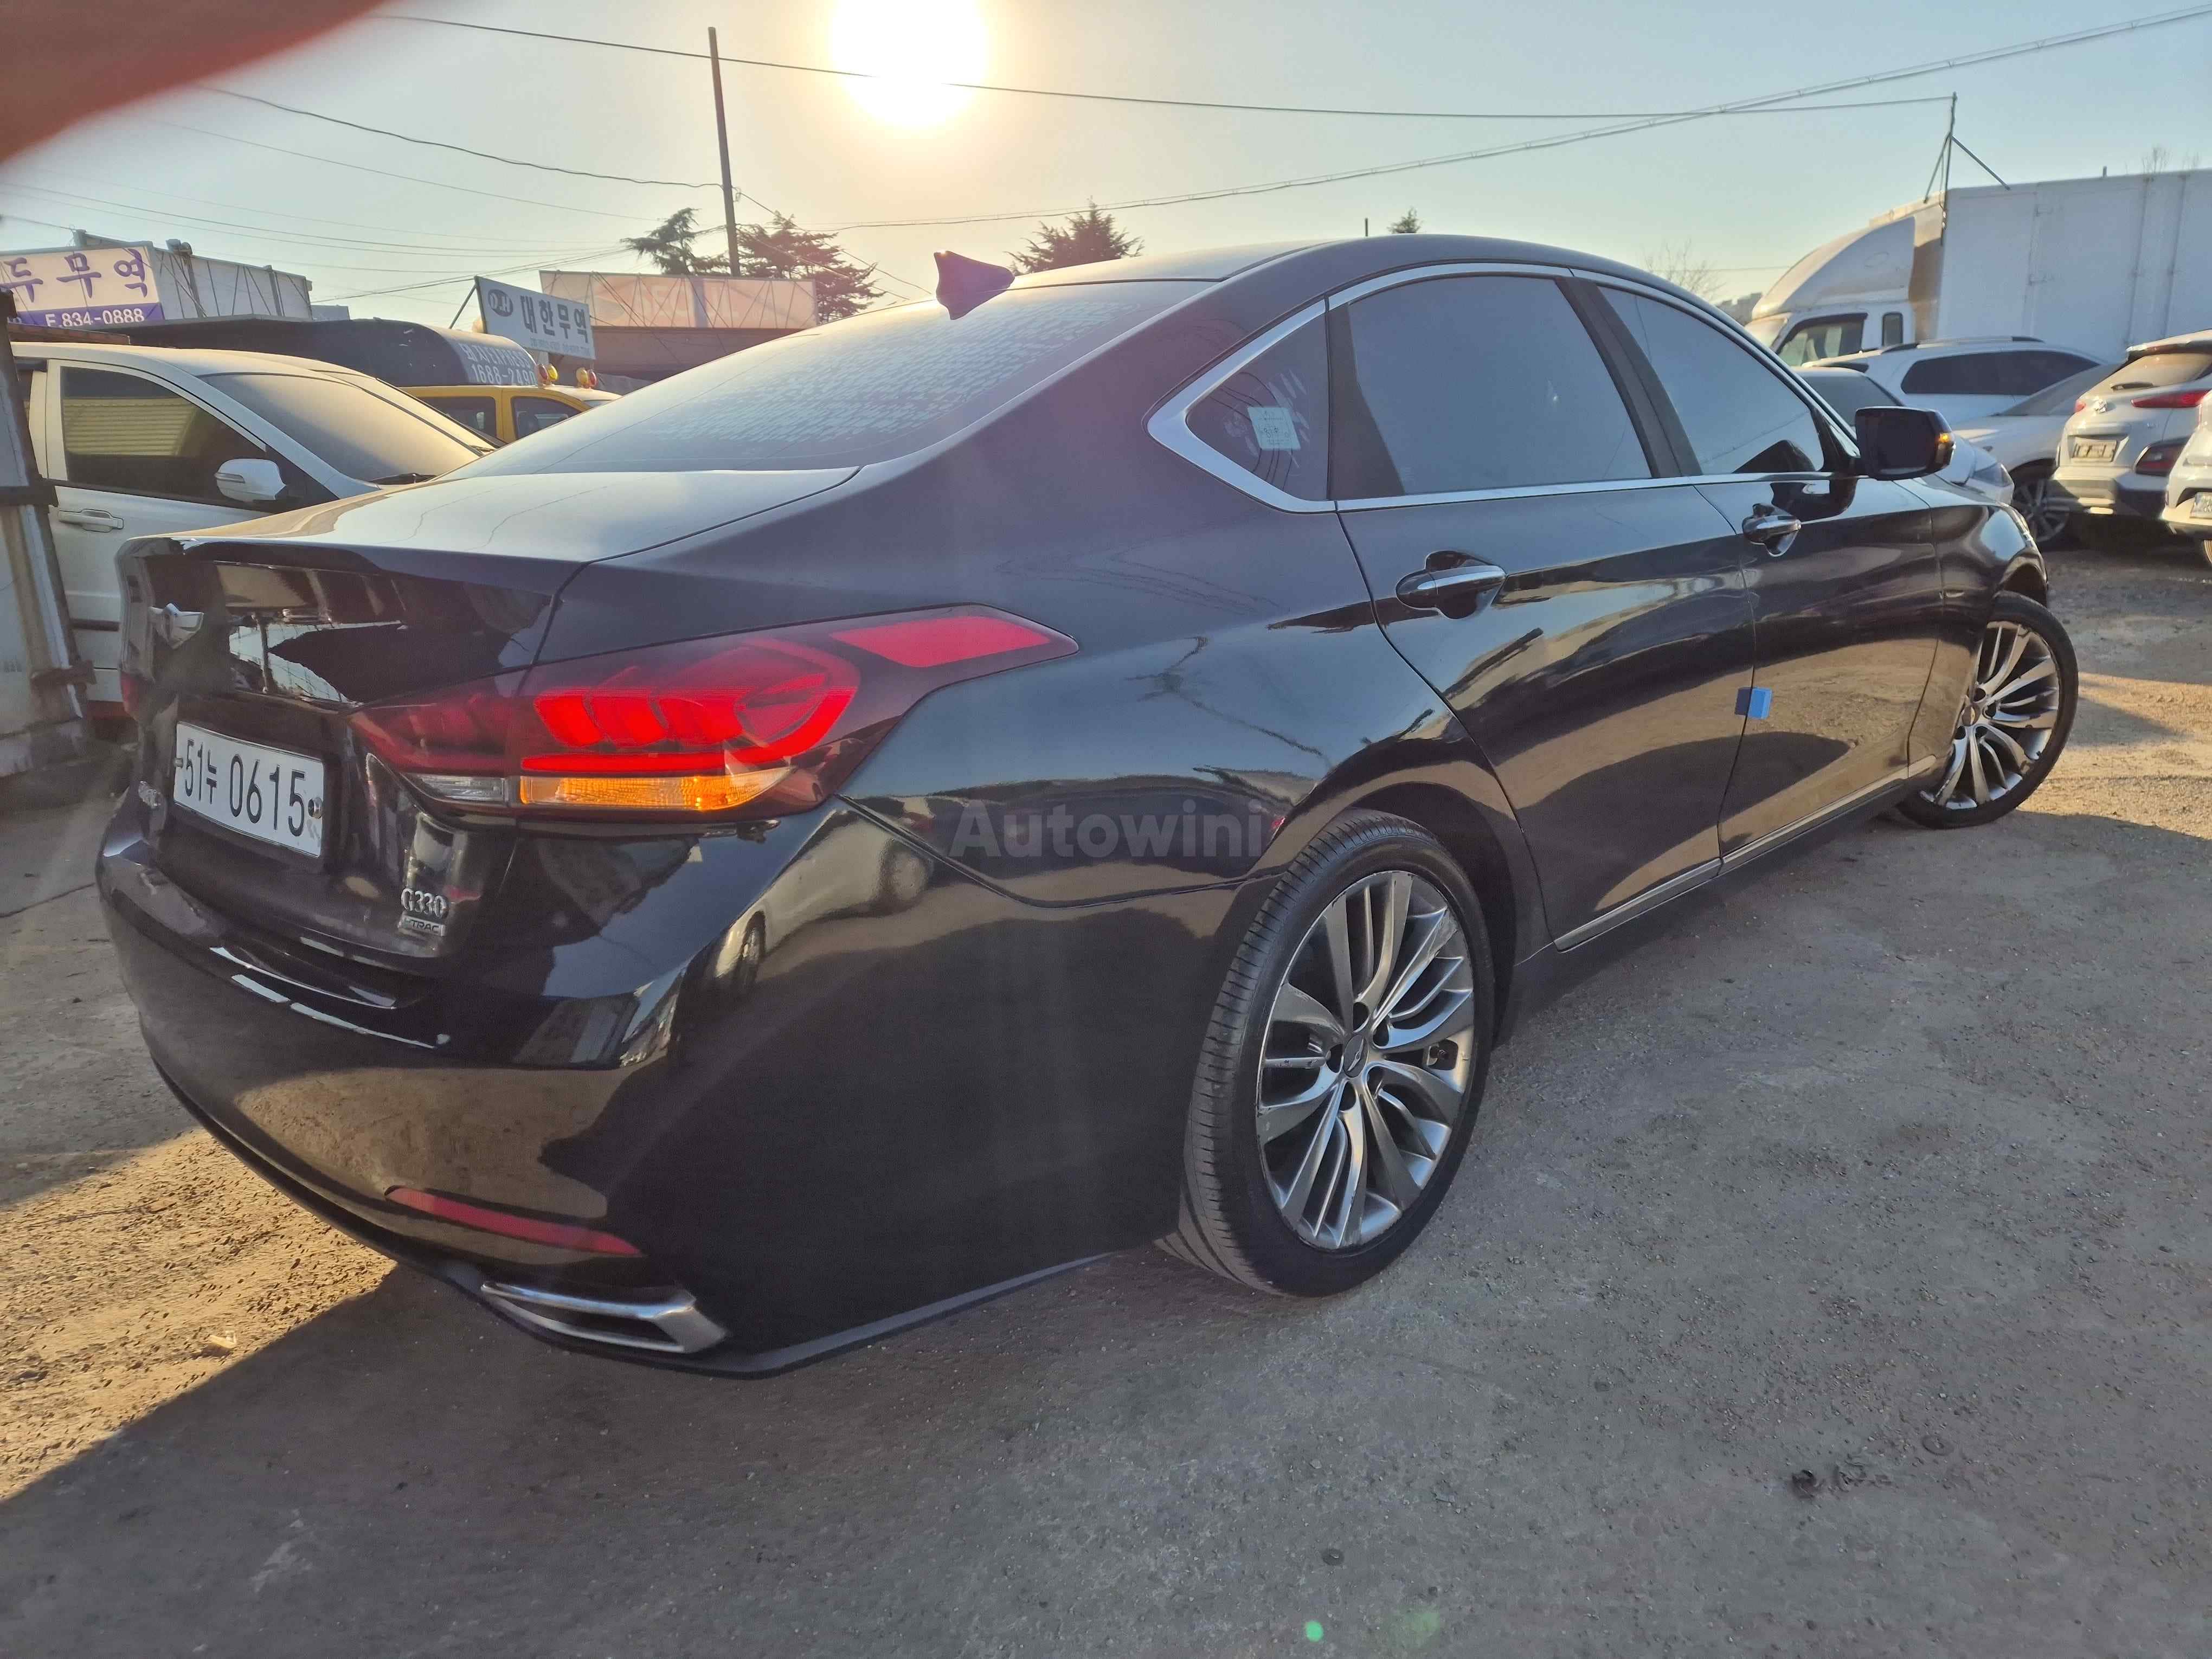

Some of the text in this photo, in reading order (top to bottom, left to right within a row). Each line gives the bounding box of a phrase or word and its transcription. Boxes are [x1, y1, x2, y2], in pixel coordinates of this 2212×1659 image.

[520, 295, 589, 344] 대한무역
[185, 738, 305, 837] 51누 0615
[401, 888, 446, 917] G330
